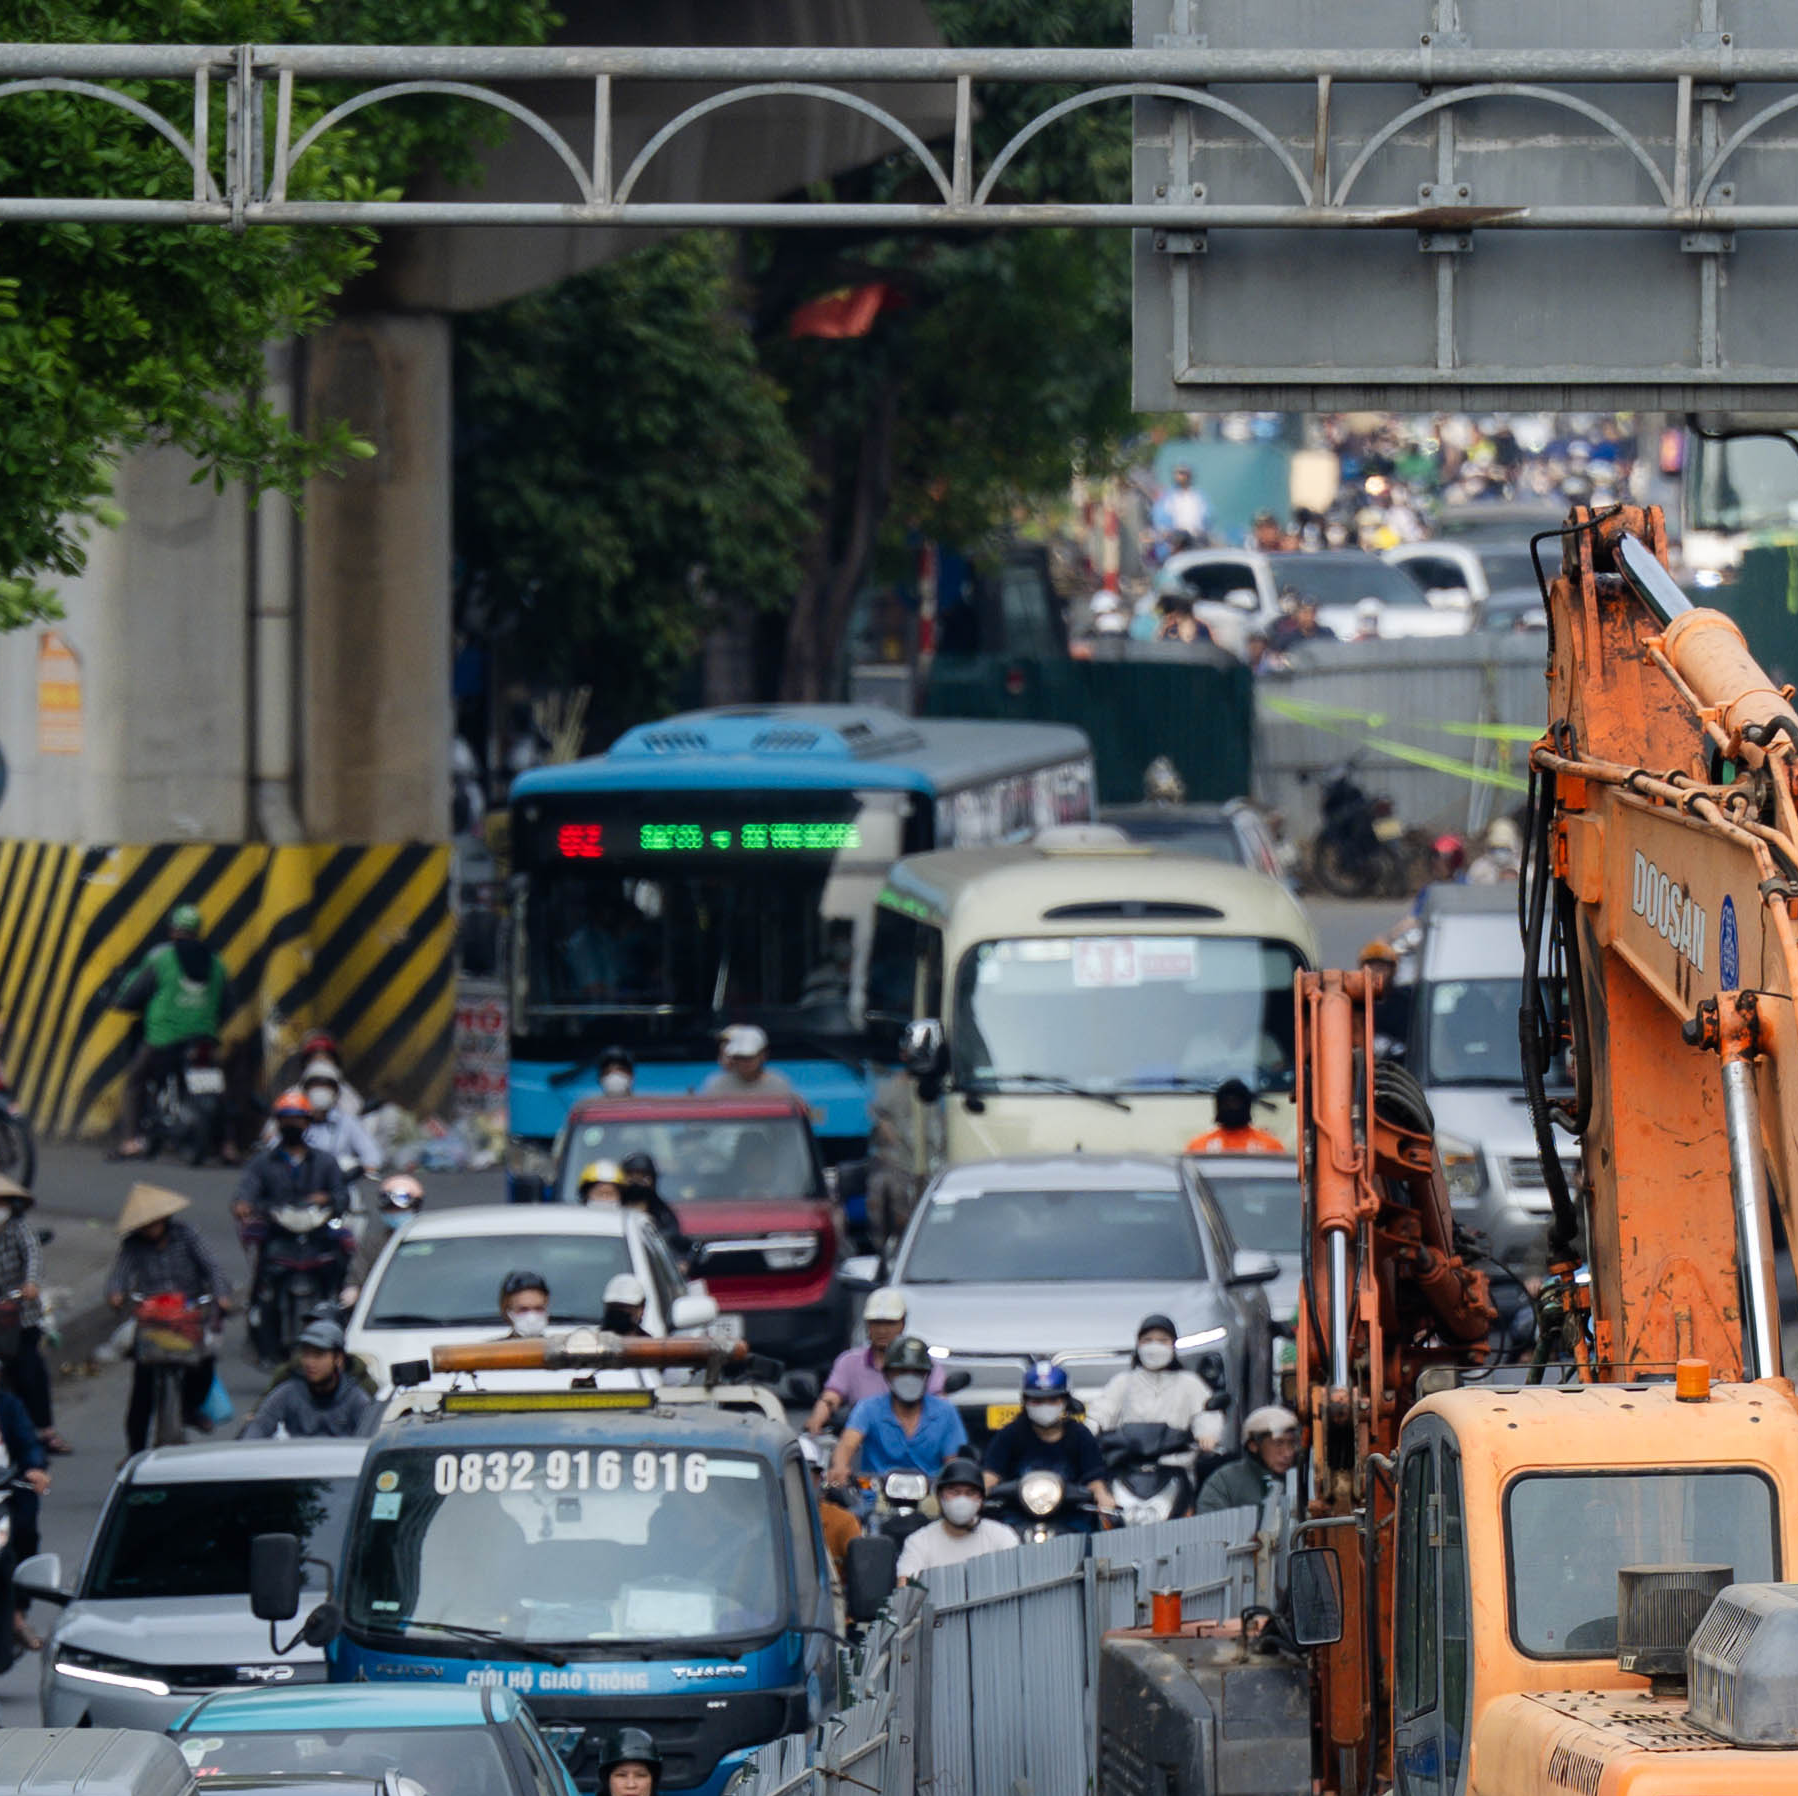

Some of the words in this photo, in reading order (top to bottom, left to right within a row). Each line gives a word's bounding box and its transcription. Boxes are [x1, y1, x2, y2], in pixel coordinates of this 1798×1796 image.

[1633, 849, 1706, 975] DOOSAN
[434, 1452, 534, 1496] 0832
[545, 1450, 621, 1493] 916
[631, 1449, 708, 1493] 916
[507, 1667, 535, 1694] HỘ
[539, 1672, 584, 1690] GIAO
[588, 1668, 650, 1692] THÔNG
[671, 1665, 748, 1681] THACO
